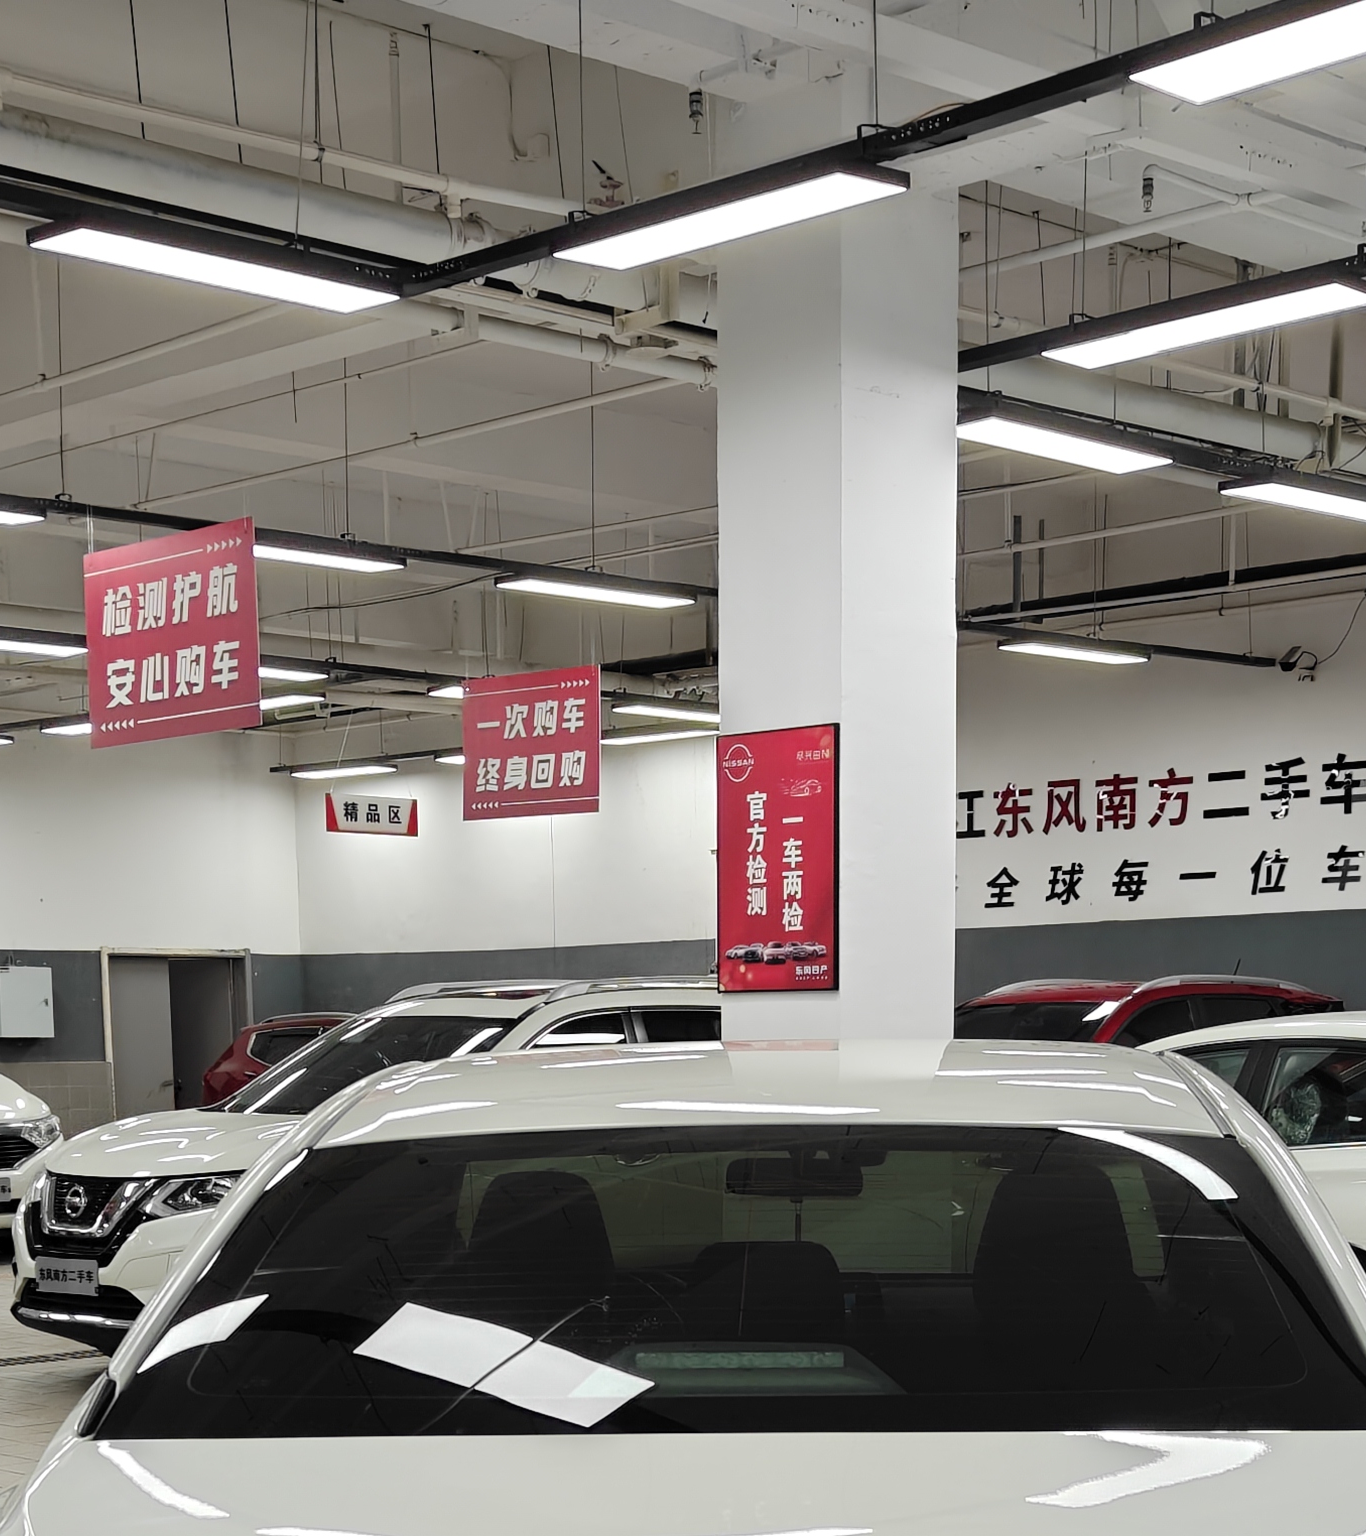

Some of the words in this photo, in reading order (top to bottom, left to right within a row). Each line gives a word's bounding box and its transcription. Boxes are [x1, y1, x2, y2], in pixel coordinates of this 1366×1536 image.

[102, 563, 238, 638] 检测护航
[105, 641, 240, 709] 安心购车
[476, 698, 586, 740] 一次购车
[475, 750, 586, 794] 终身回购
[722, 758, 755, 769] NISSAN
[343, 801, 402, 824] 精品区
[746, 791, 768, 916] 官方检测
[782, 816, 804, 932] 一车两检
